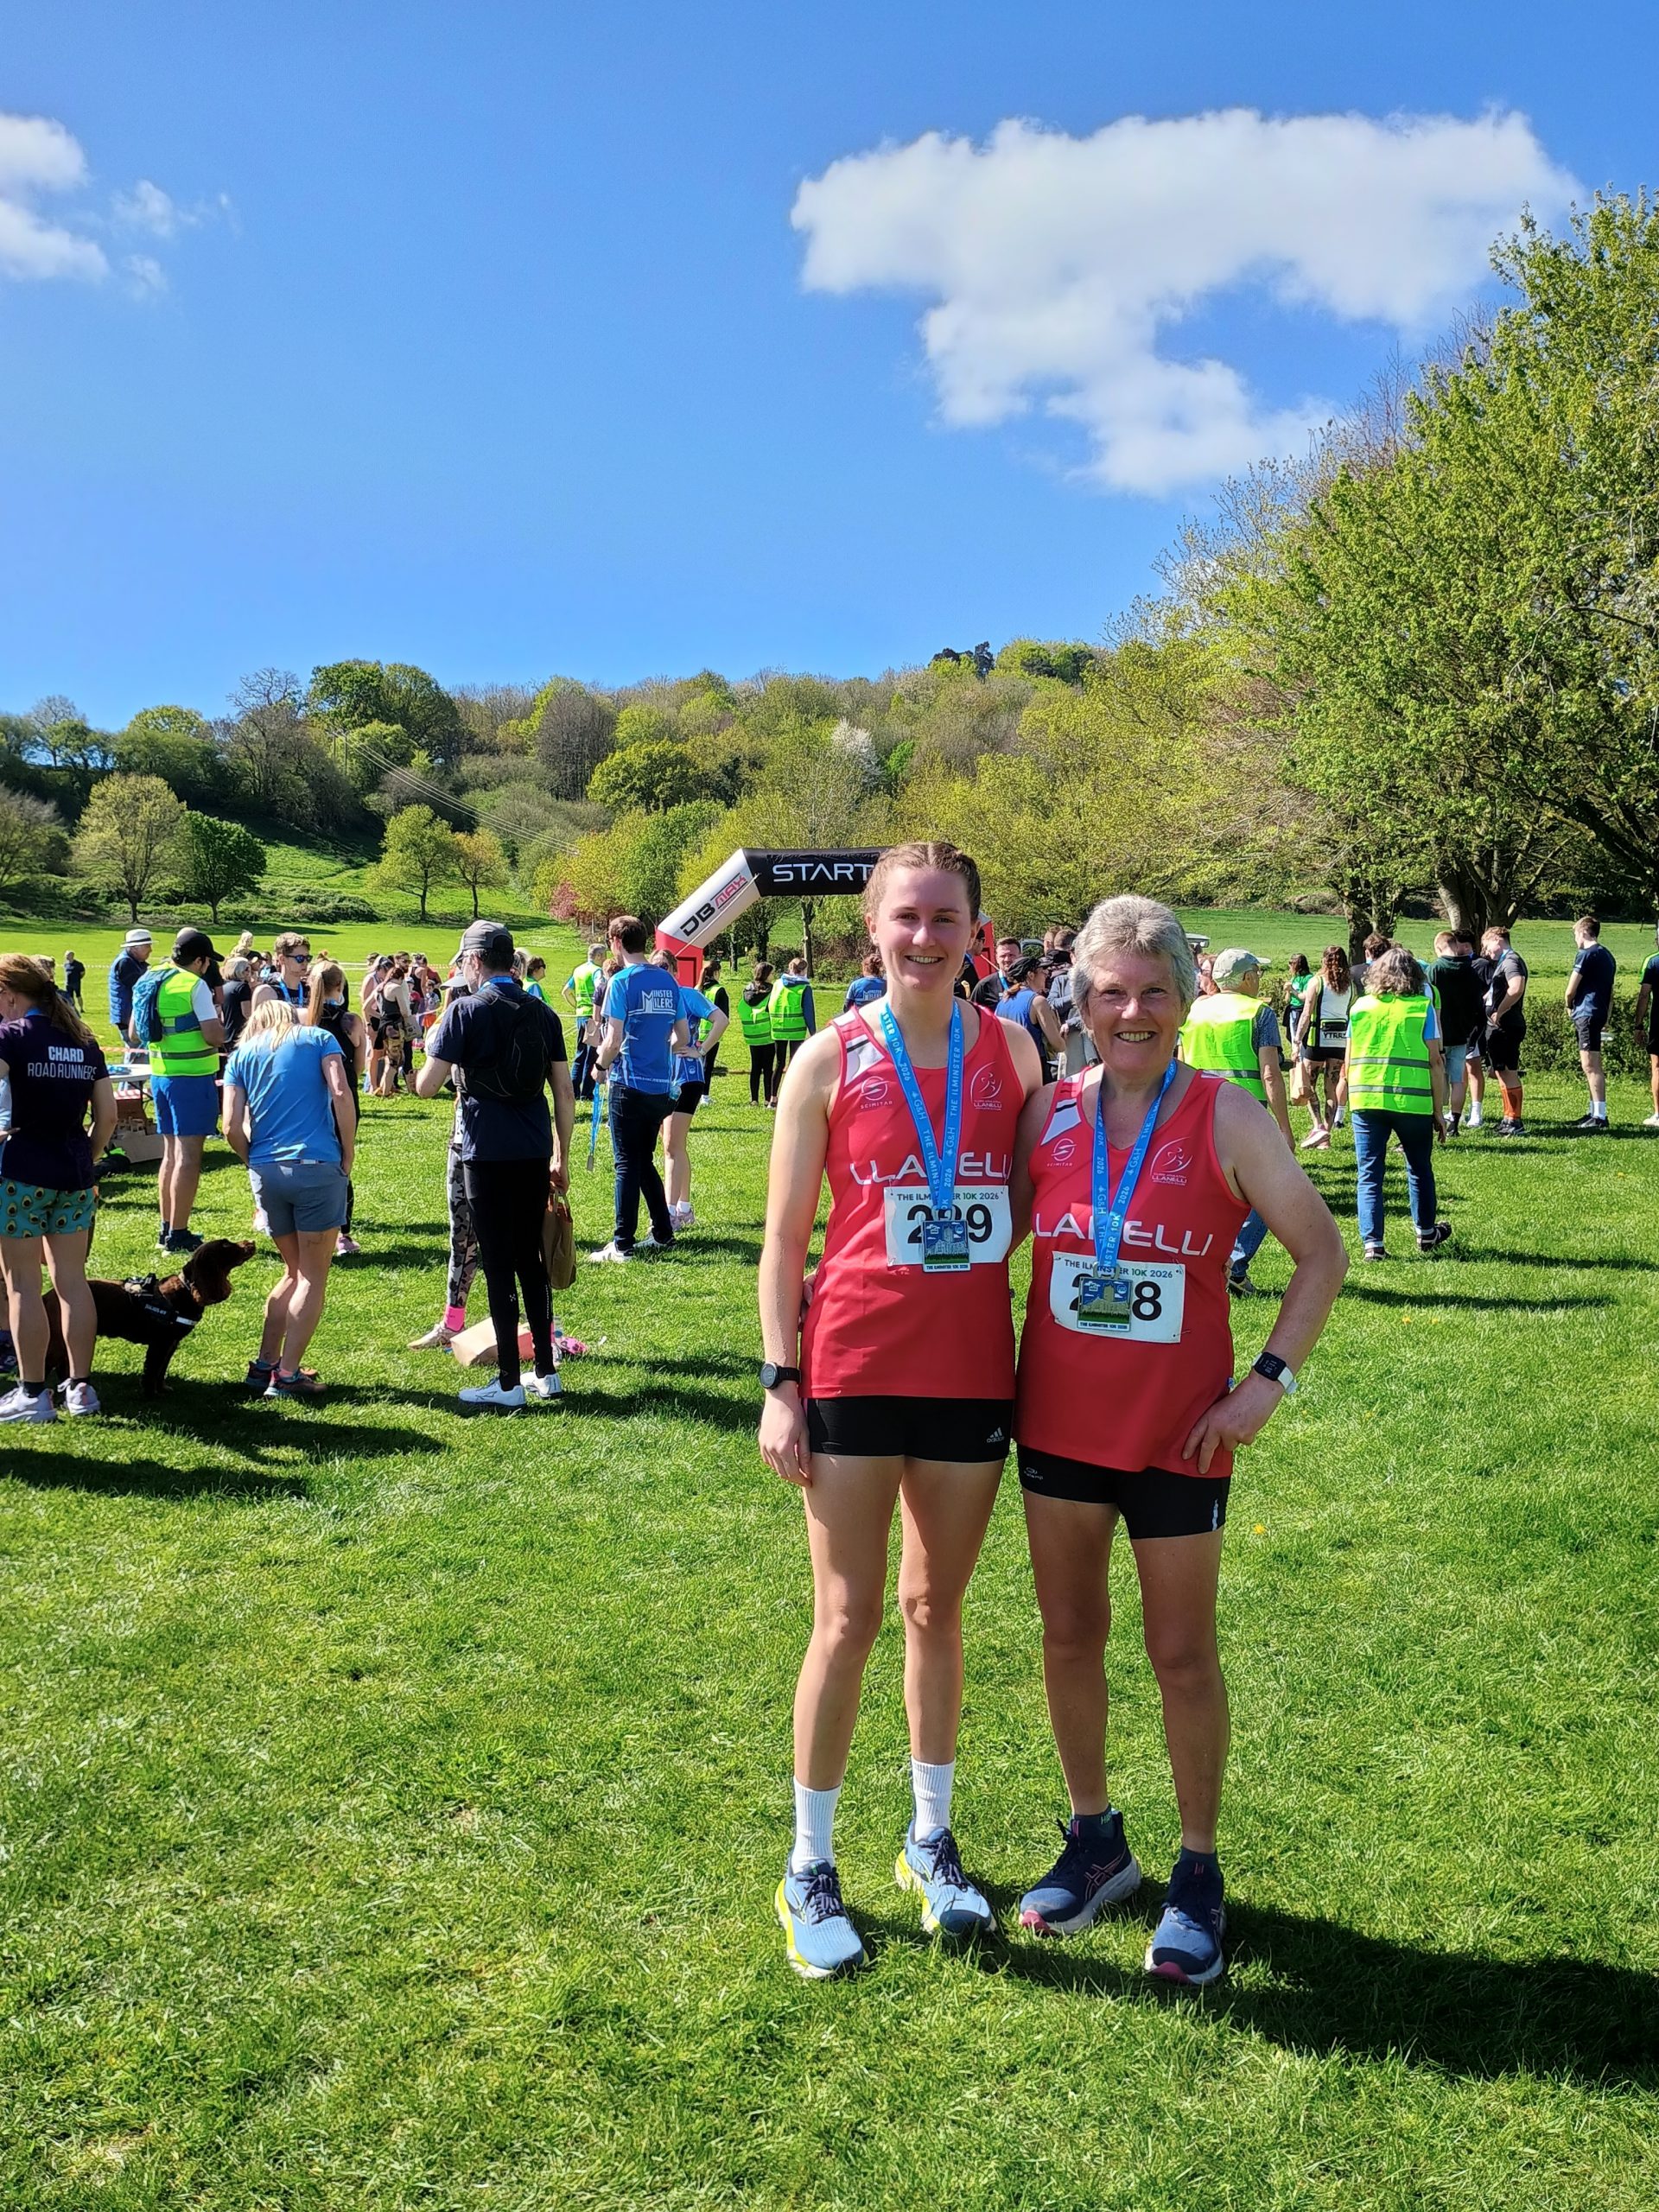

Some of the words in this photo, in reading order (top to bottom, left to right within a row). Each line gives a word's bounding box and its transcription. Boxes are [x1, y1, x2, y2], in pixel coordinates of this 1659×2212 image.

[772, 863, 874, 882] START
[680, 902, 715, 937] DB
[715, 874, 747, 906] MAX
[48, 1046, 84, 1062] CHARD
[28, 1062, 57, 1078] ROAD
[57, 1063, 97, 1081] RUNNERS
[951, 1047, 961, 1096] ILMINSTER
[892, 1038, 903, 1053] 10K
[900, 1063, 911, 1081] 2026
[913, 1099, 927, 1120] G&H
[924, 1129, 932, 1147] THE
[861, 1100, 893, 1109] SCIMITAR
[946, 1127, 956, 1147] G&H
[850, 1152, 1013, 1185] LLAELLI
[944, 1168, 952, 1187] 2026
[916, 1192, 961, 1201] ILMER
[979, 1192, 1000, 1200] 2026
[1097, 1193, 1107, 1215] G&H
[1103, 1237, 1116, 1267] NSTER
[1111, 1214, 1121, 1232] 10K
[1118, 1185, 1130, 1205] 2026
[1130, 1147, 1142, 1167] G&H
[1065, 1259, 1080, 1268] THE
[1150, 1270, 1173, 1279] 2026
